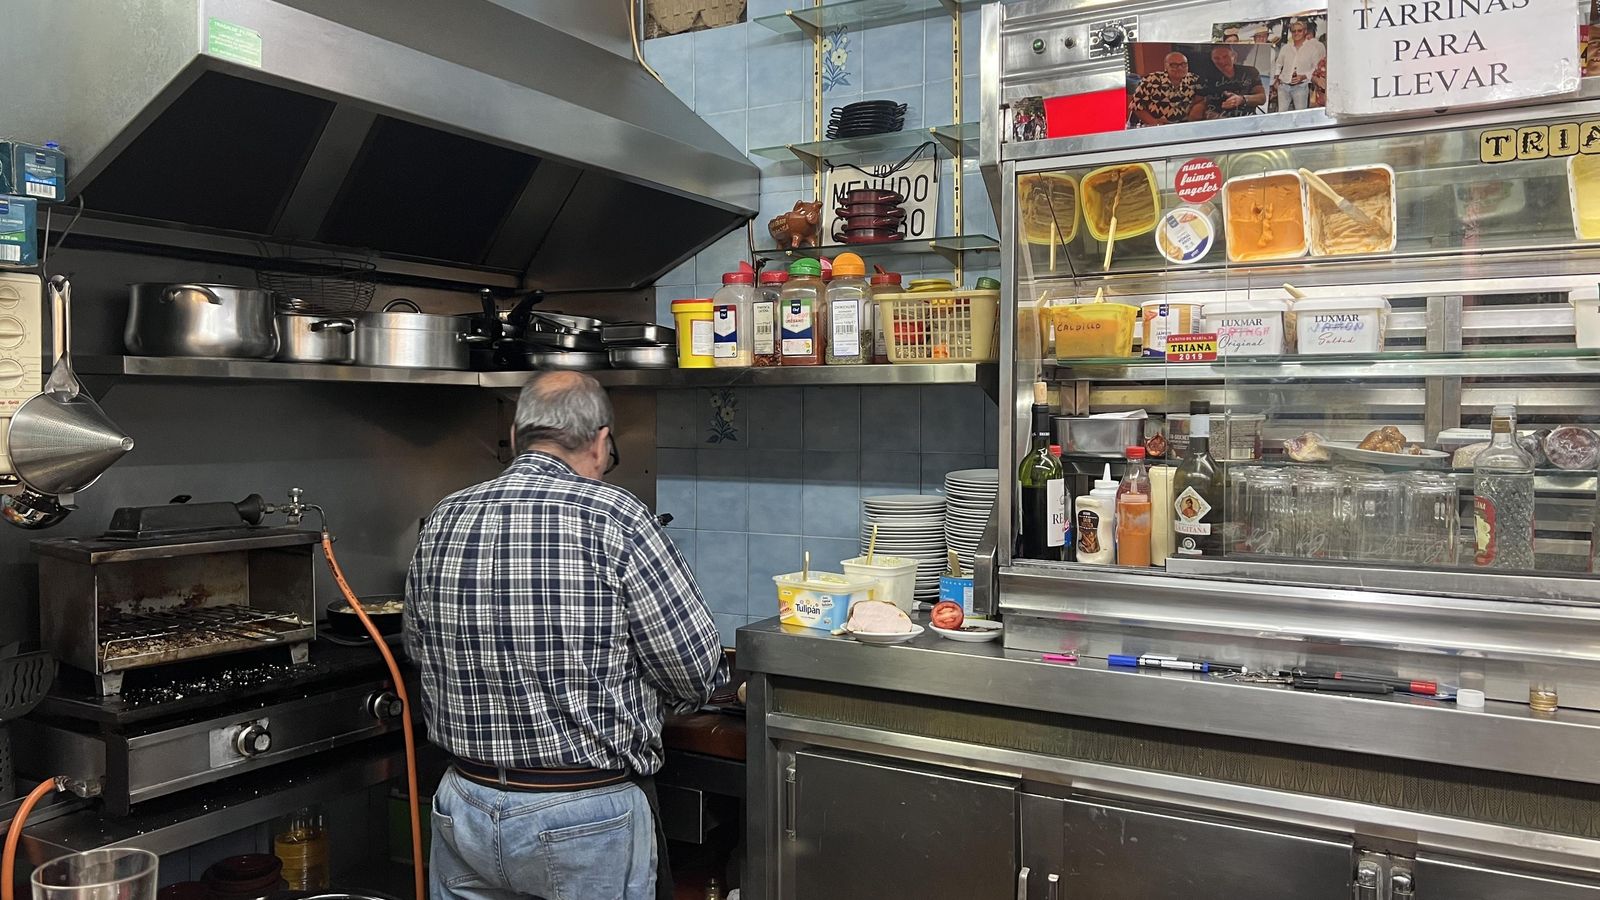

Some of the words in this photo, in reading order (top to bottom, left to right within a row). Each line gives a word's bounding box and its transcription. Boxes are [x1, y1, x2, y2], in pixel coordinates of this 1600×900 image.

[1393, 30, 1488, 62] PARA
[1371, 62, 1512, 99] LLEVAR
[1182, 161, 1214, 172] nunca
[1180, 172, 1216, 186] fuimos
[1221, 318, 1263, 327] LUXMAR
[1314, 313, 1360, 323] LUXMAR
[1170, 343, 1212, 352] TRIANA
[1218, 334, 1265, 353] Original
[1179, 353, 1203, 361] 2019
[795, 602, 821, 615] Tulipán
